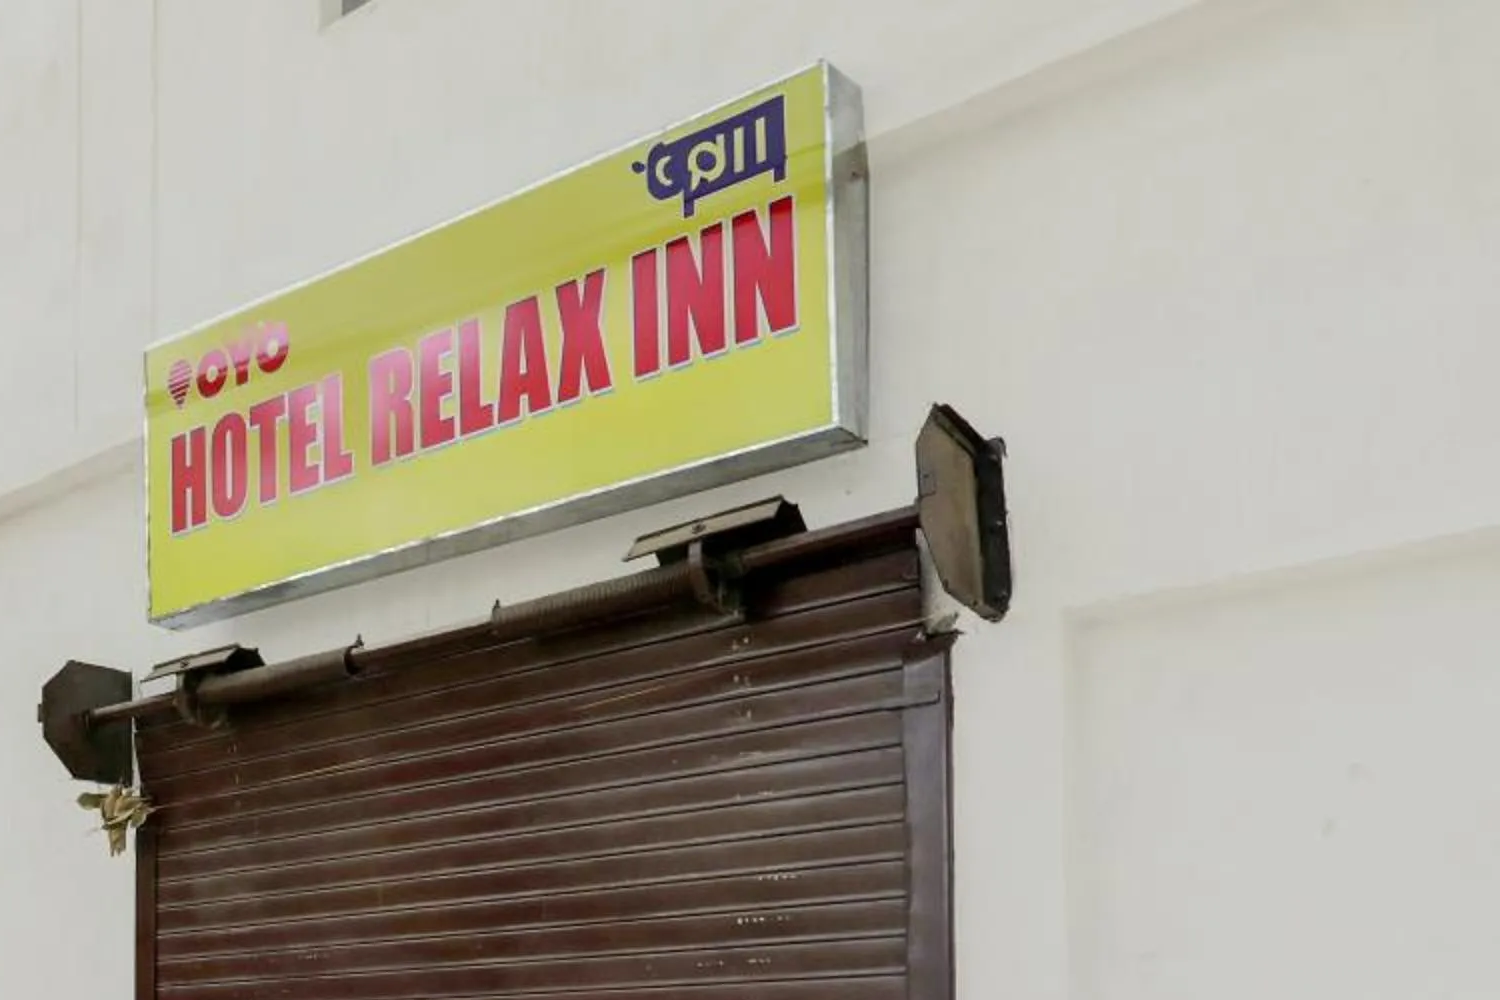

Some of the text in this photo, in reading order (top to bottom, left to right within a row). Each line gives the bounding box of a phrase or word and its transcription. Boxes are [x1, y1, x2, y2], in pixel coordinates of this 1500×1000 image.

[170, 196, 799, 534] HOTEL RELAX INN
[195, 320, 291, 399] OYO
